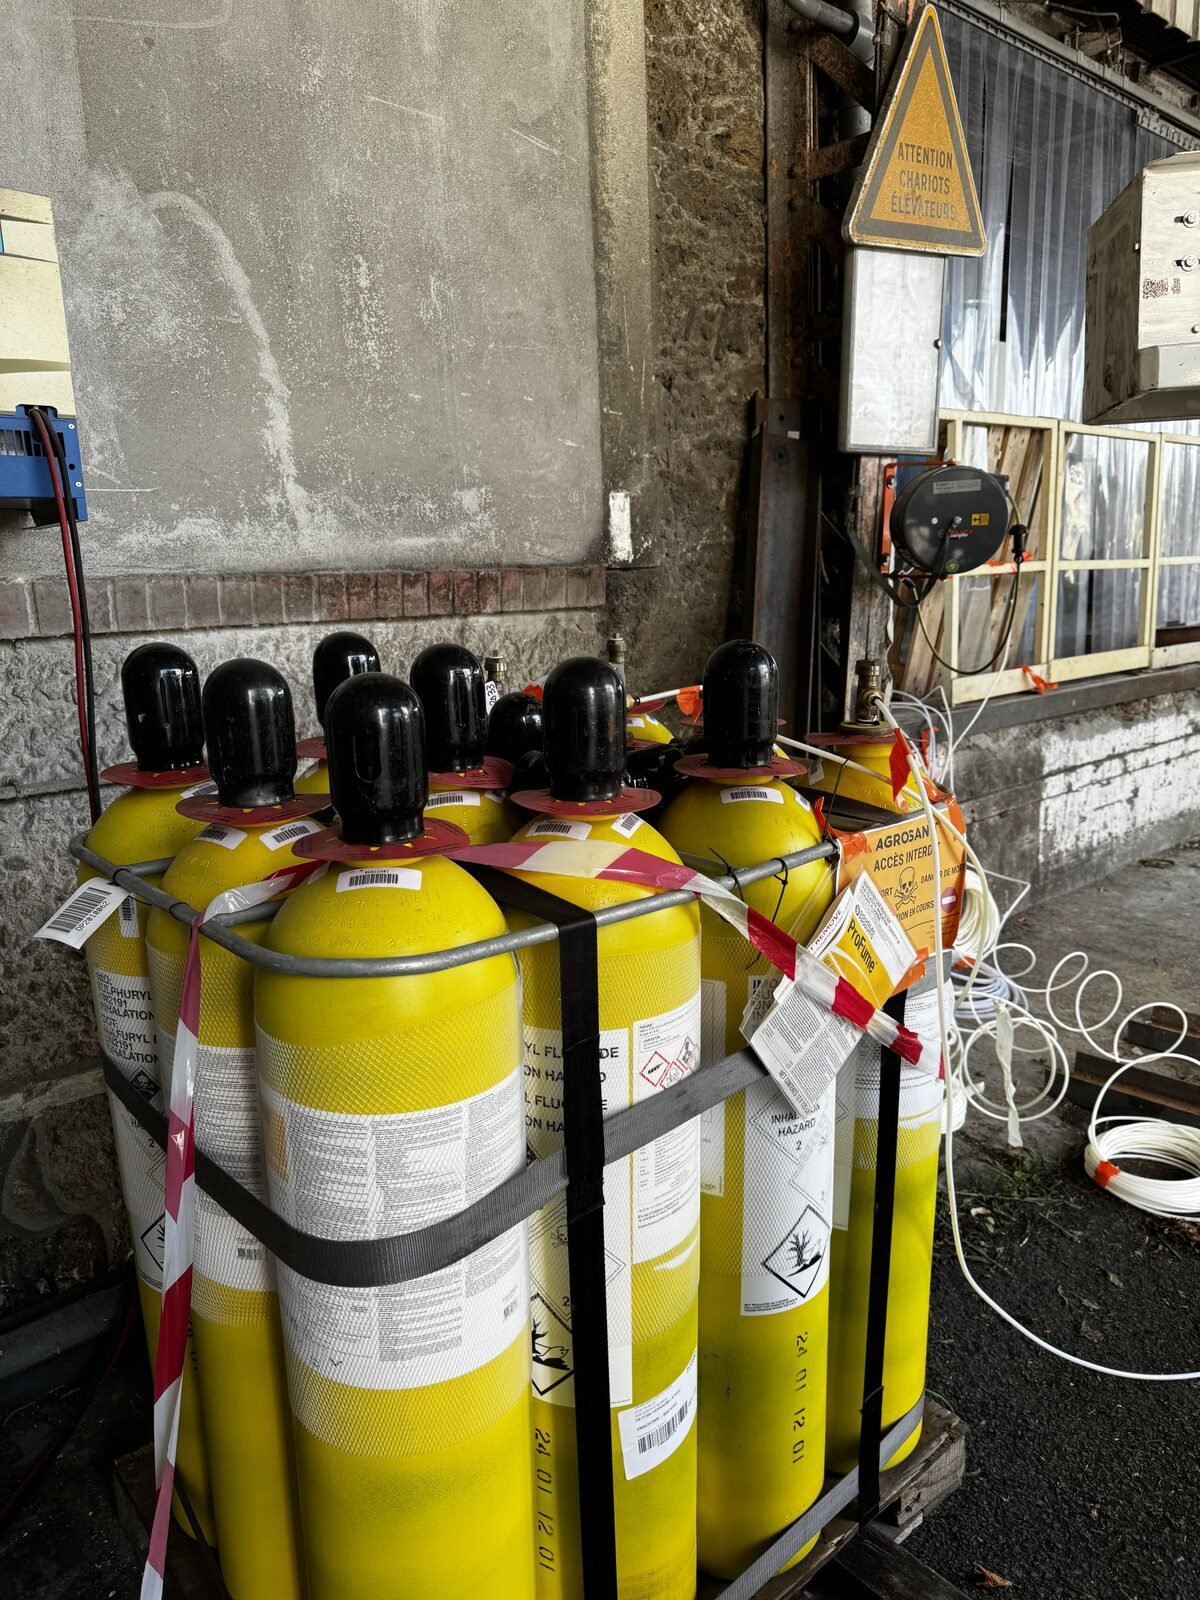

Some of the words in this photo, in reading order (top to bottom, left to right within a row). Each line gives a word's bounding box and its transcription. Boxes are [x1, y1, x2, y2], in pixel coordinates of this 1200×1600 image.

[898, 142, 953, 169] ATTENTION
[900, 169, 950, 194] CHARIOTS
[891, 191, 956, 221] ÉLÉVATEURS
[876, 821, 939, 852] AGROSAN
[873, 852, 904, 872] ACCÈS
[905, 841, 941, 864] INTERD
[944, 869, 951, 877] DE
[951, 863, 966, 875] MORT
[880, 887, 894, 898] ORT
[909, 906, 916, 917] EN
[915, 899, 935, 914] COURS
[847, 918, 876, 974] ProFume
[524, 1041, 541, 1056] YL
[523, 1063, 541, 1080] ON
[525, 1114, 541, 1130] ON
[778, 1117, 816, 1137] HAZARD
[796, 1140, 802, 1151] 2
[562, 1296, 570, 1307] 2
[795, 1368, 807, 1392] 01
[793, 1407, 806, 1432] 12
[535, 1427, 551, 1457] 24
[792, 1439, 805, 1464] 01
[536, 1468, 552, 1495] 01
[537, 1511, 553, 1537] 12
[539, 1546, 555, 1573] 01
